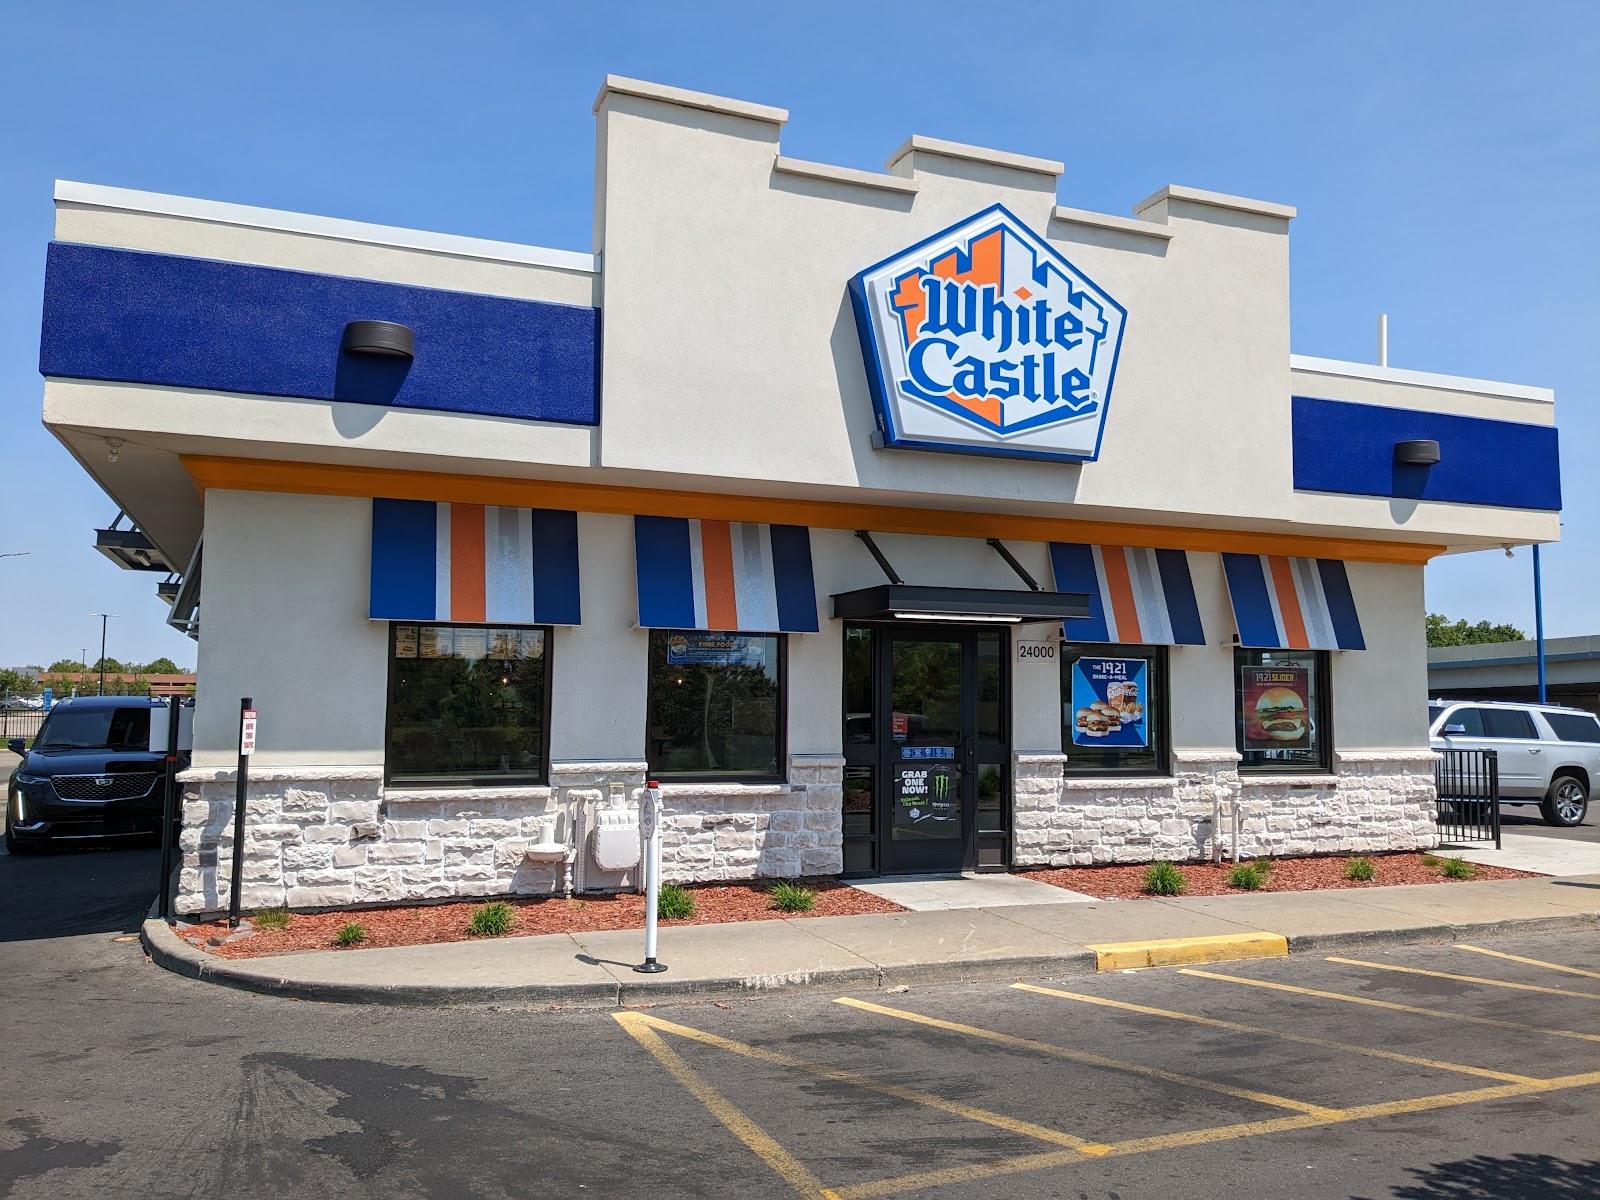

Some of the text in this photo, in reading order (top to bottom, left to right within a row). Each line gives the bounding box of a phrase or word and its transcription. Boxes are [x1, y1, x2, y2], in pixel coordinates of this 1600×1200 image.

[919, 277, 1083, 353] White
[908, 337, 1090, 407] Castle
[1020, 646, 1054, 658] 24000
[1101, 662, 1126, 674] 1921
[1256, 673, 1271, 681] 1921
[902, 786, 928, 794] NOW!
